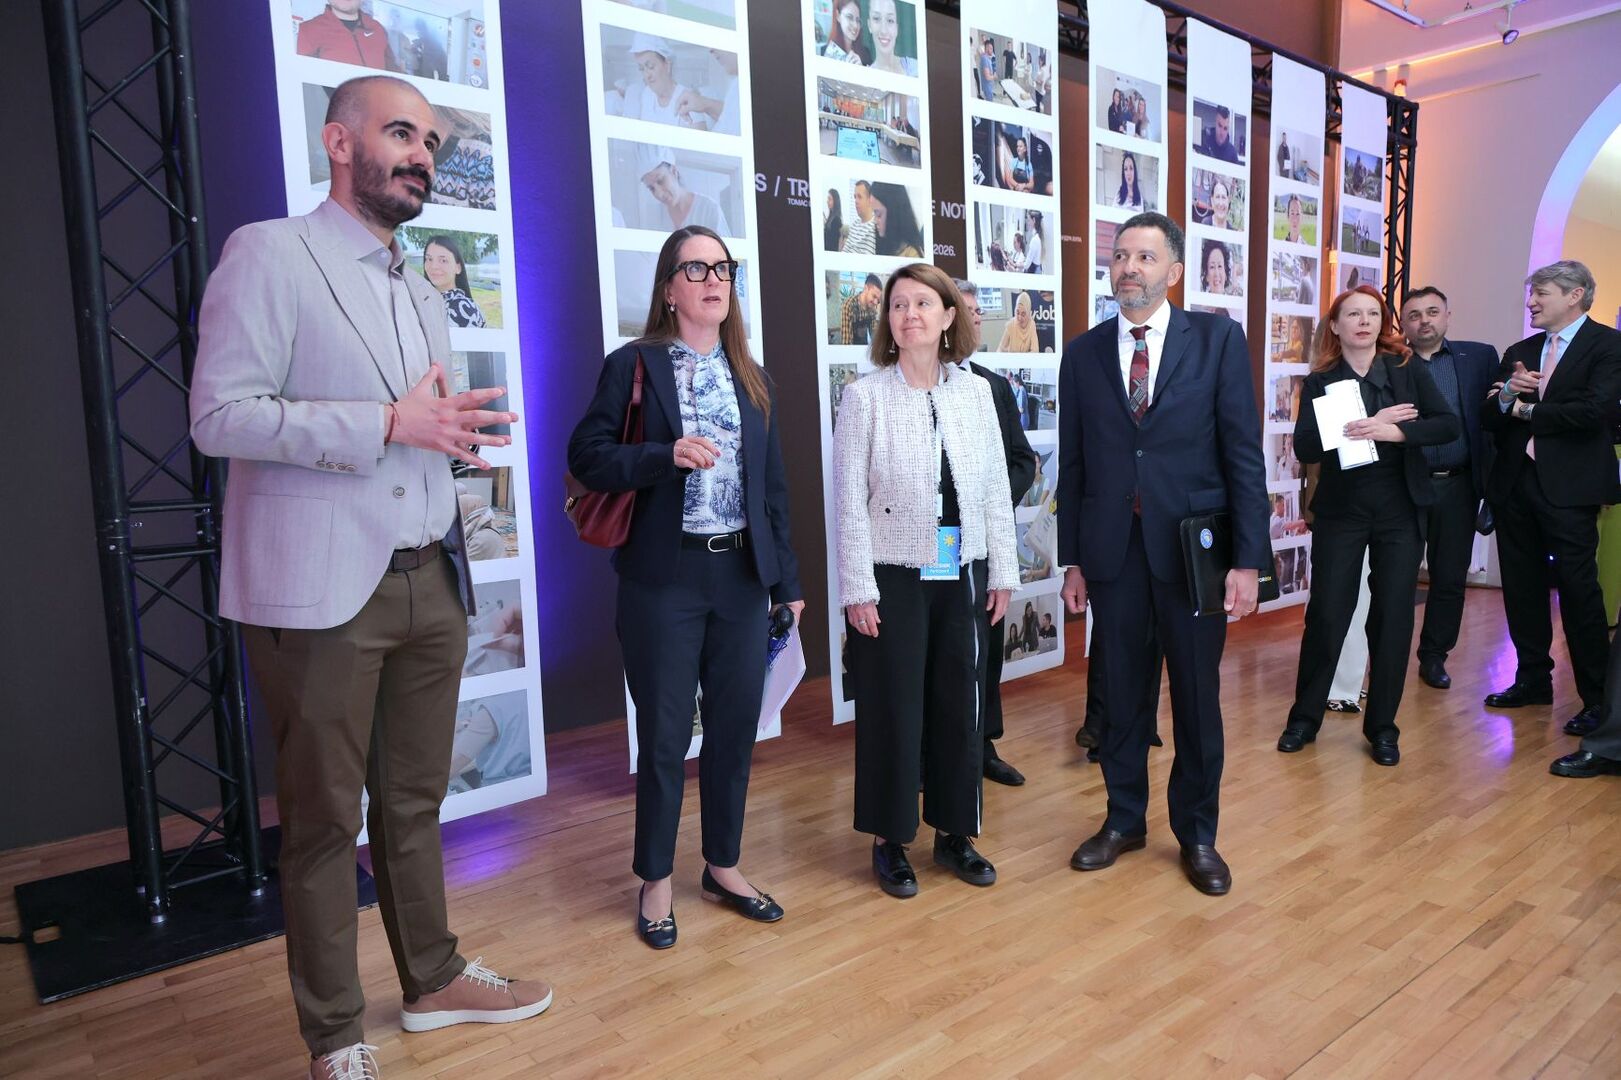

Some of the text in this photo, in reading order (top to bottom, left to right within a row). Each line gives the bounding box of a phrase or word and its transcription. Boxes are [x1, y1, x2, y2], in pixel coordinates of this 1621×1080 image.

[755, 173, 767, 192] S
[787, 178, 809, 198] TR
[933, 244, 956, 256] 2026.
